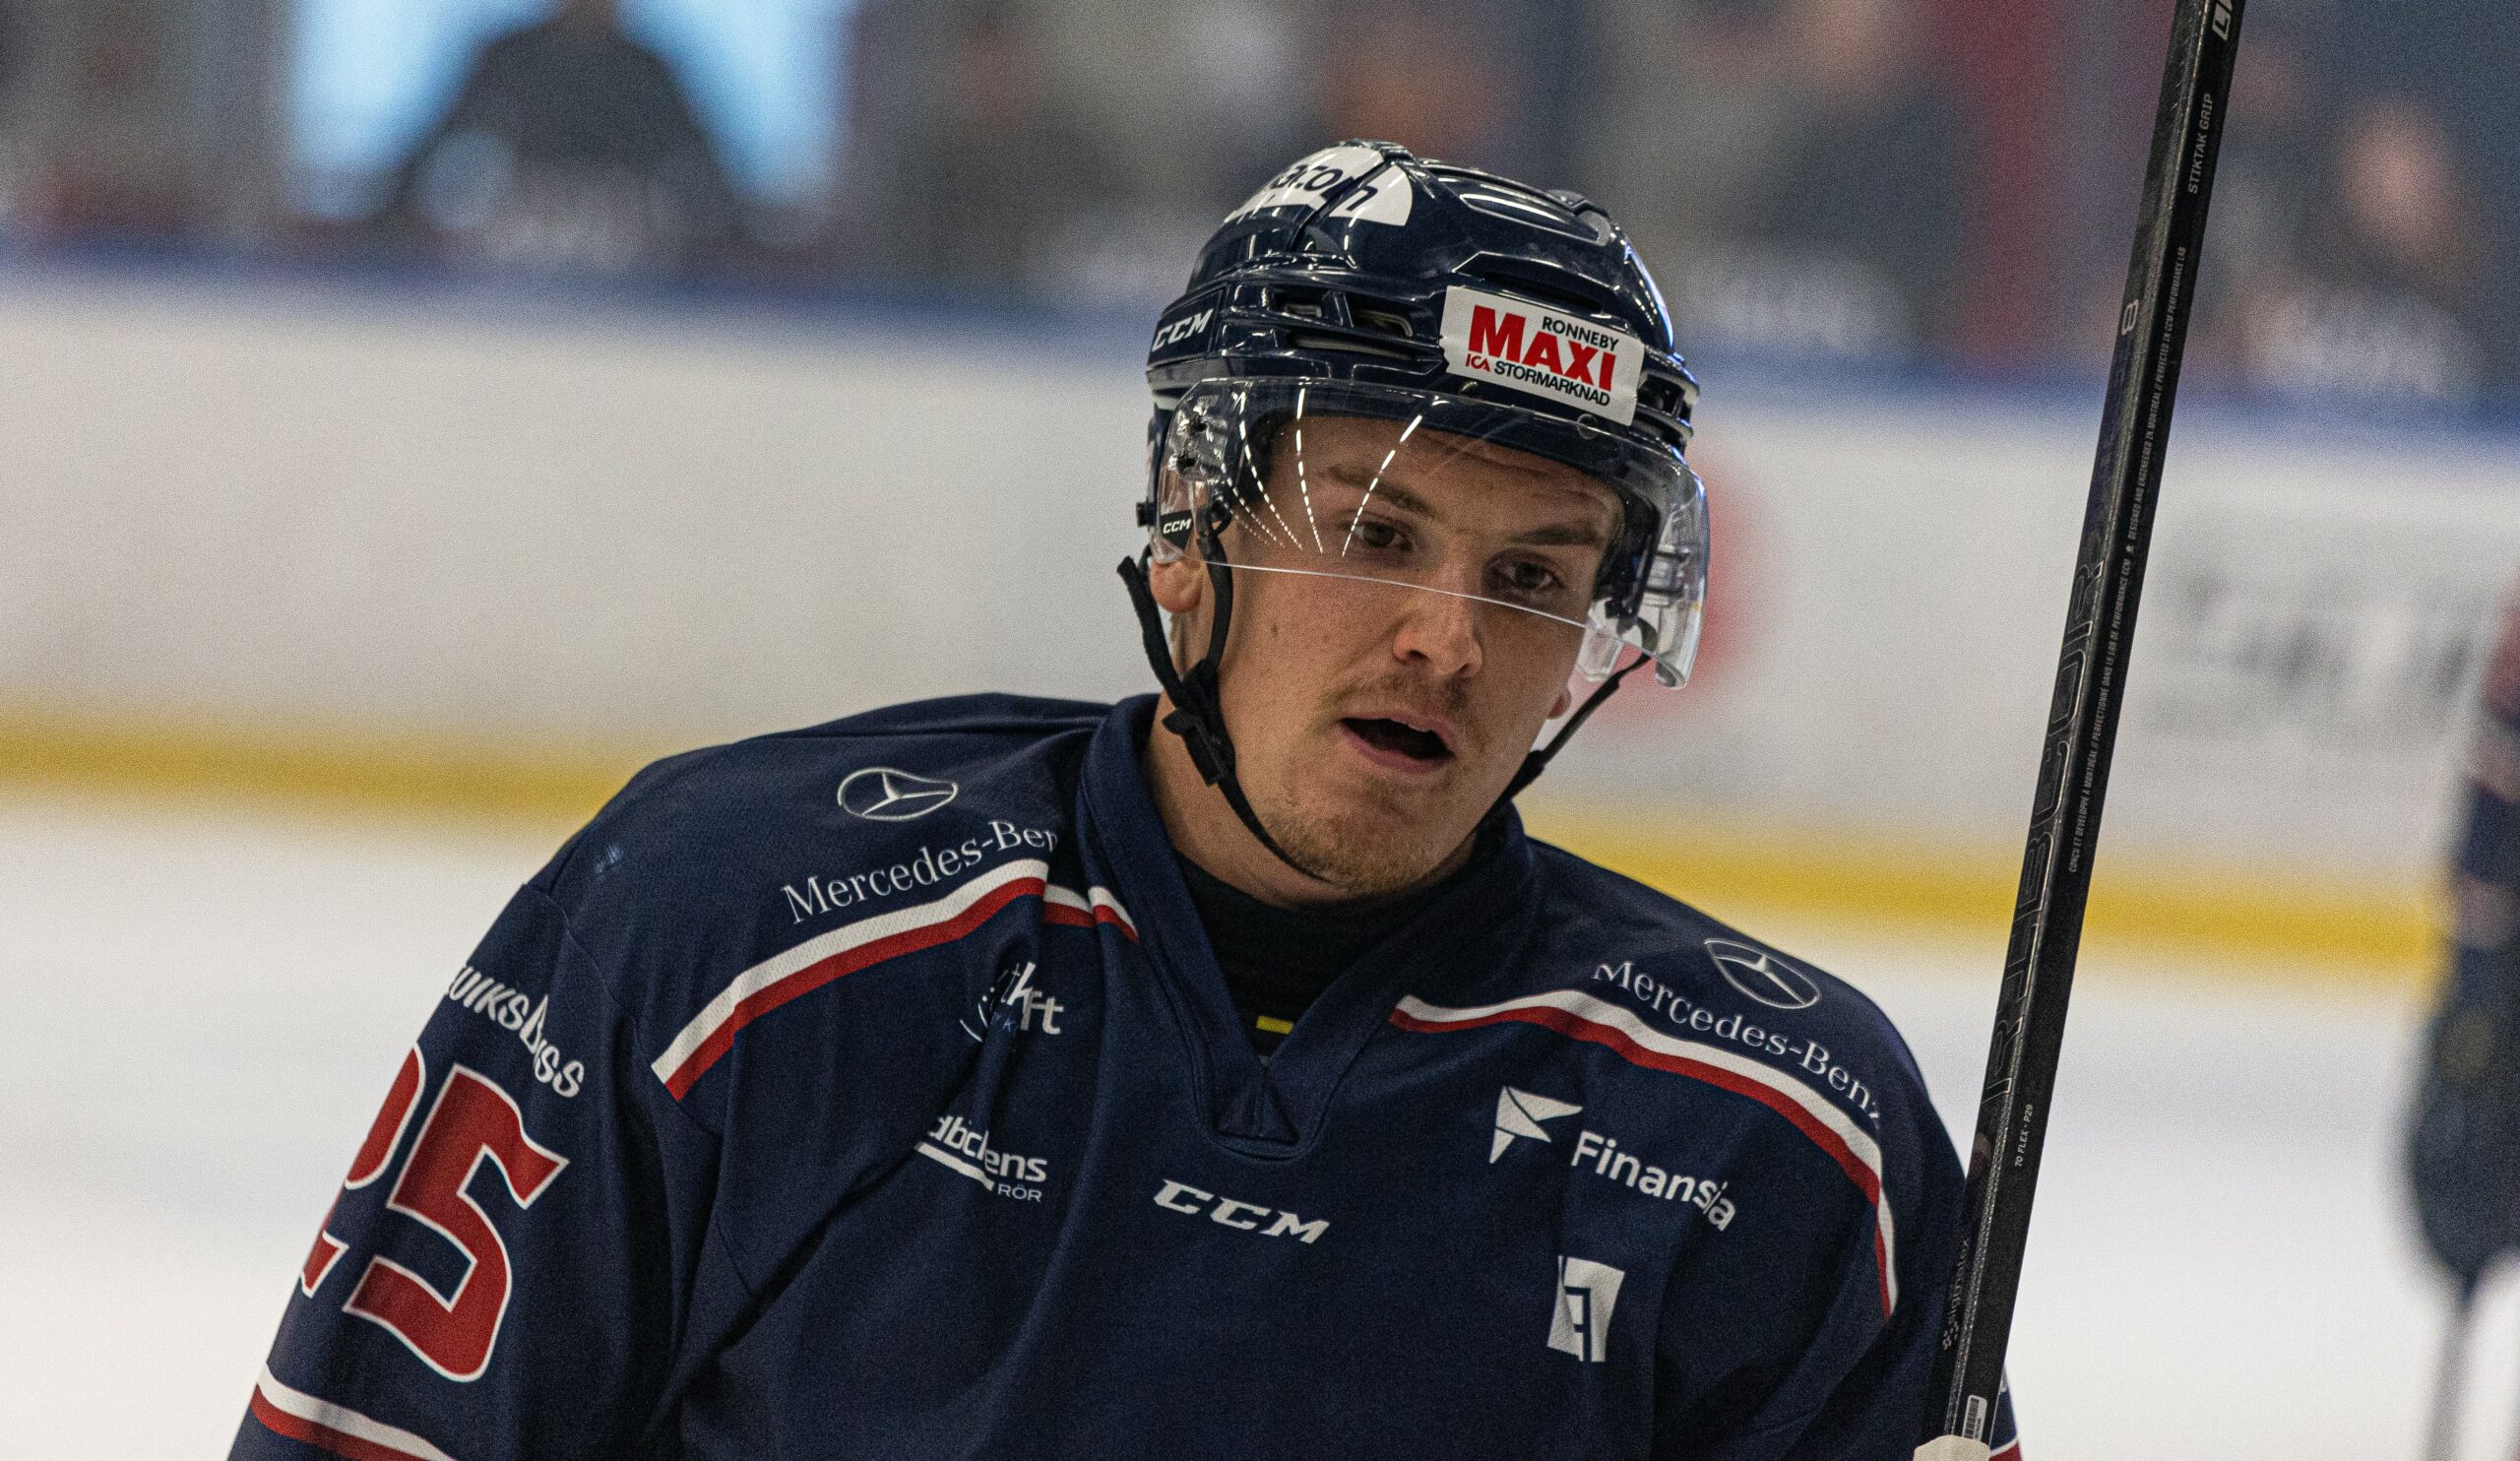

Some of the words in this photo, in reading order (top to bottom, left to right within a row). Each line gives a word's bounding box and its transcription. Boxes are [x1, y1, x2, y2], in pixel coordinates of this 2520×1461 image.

[2188, 132, 2206, 194] STIKTAK
[2199, 94, 2213, 130] GRIP
[2175, 245, 2186, 261] LAB
[2167, 261, 2183, 314] PERFORMANCE
[1151, 308, 1214, 352] CCM
[1542, 316, 1619, 351] RONNEBY
[2163, 313, 2174, 332] CCM
[1468, 304, 1616, 391] MAXI
[2161, 332, 2171, 343] IN
[2154, 342, 2169, 383] PERFECTED
[1465, 352, 1490, 372] ICA
[1494, 360, 1610, 406] STORMARKNAD
[2144, 429, 2154, 440] IN
[1163, 518, 1192, 534] CCM
[2120, 557, 2131, 576] CCM
[781, 820, 1058, 925] Mercedes-Ben
[2023, 1103, 2033, 1122] P29
[2017, 1129, 2028, 1154] FLEX
[2014, 1154, 2023, 1167] 70
[997, 1183, 1042, 1202] RÖR
[1153, 1178, 1330, 1244] CCM
